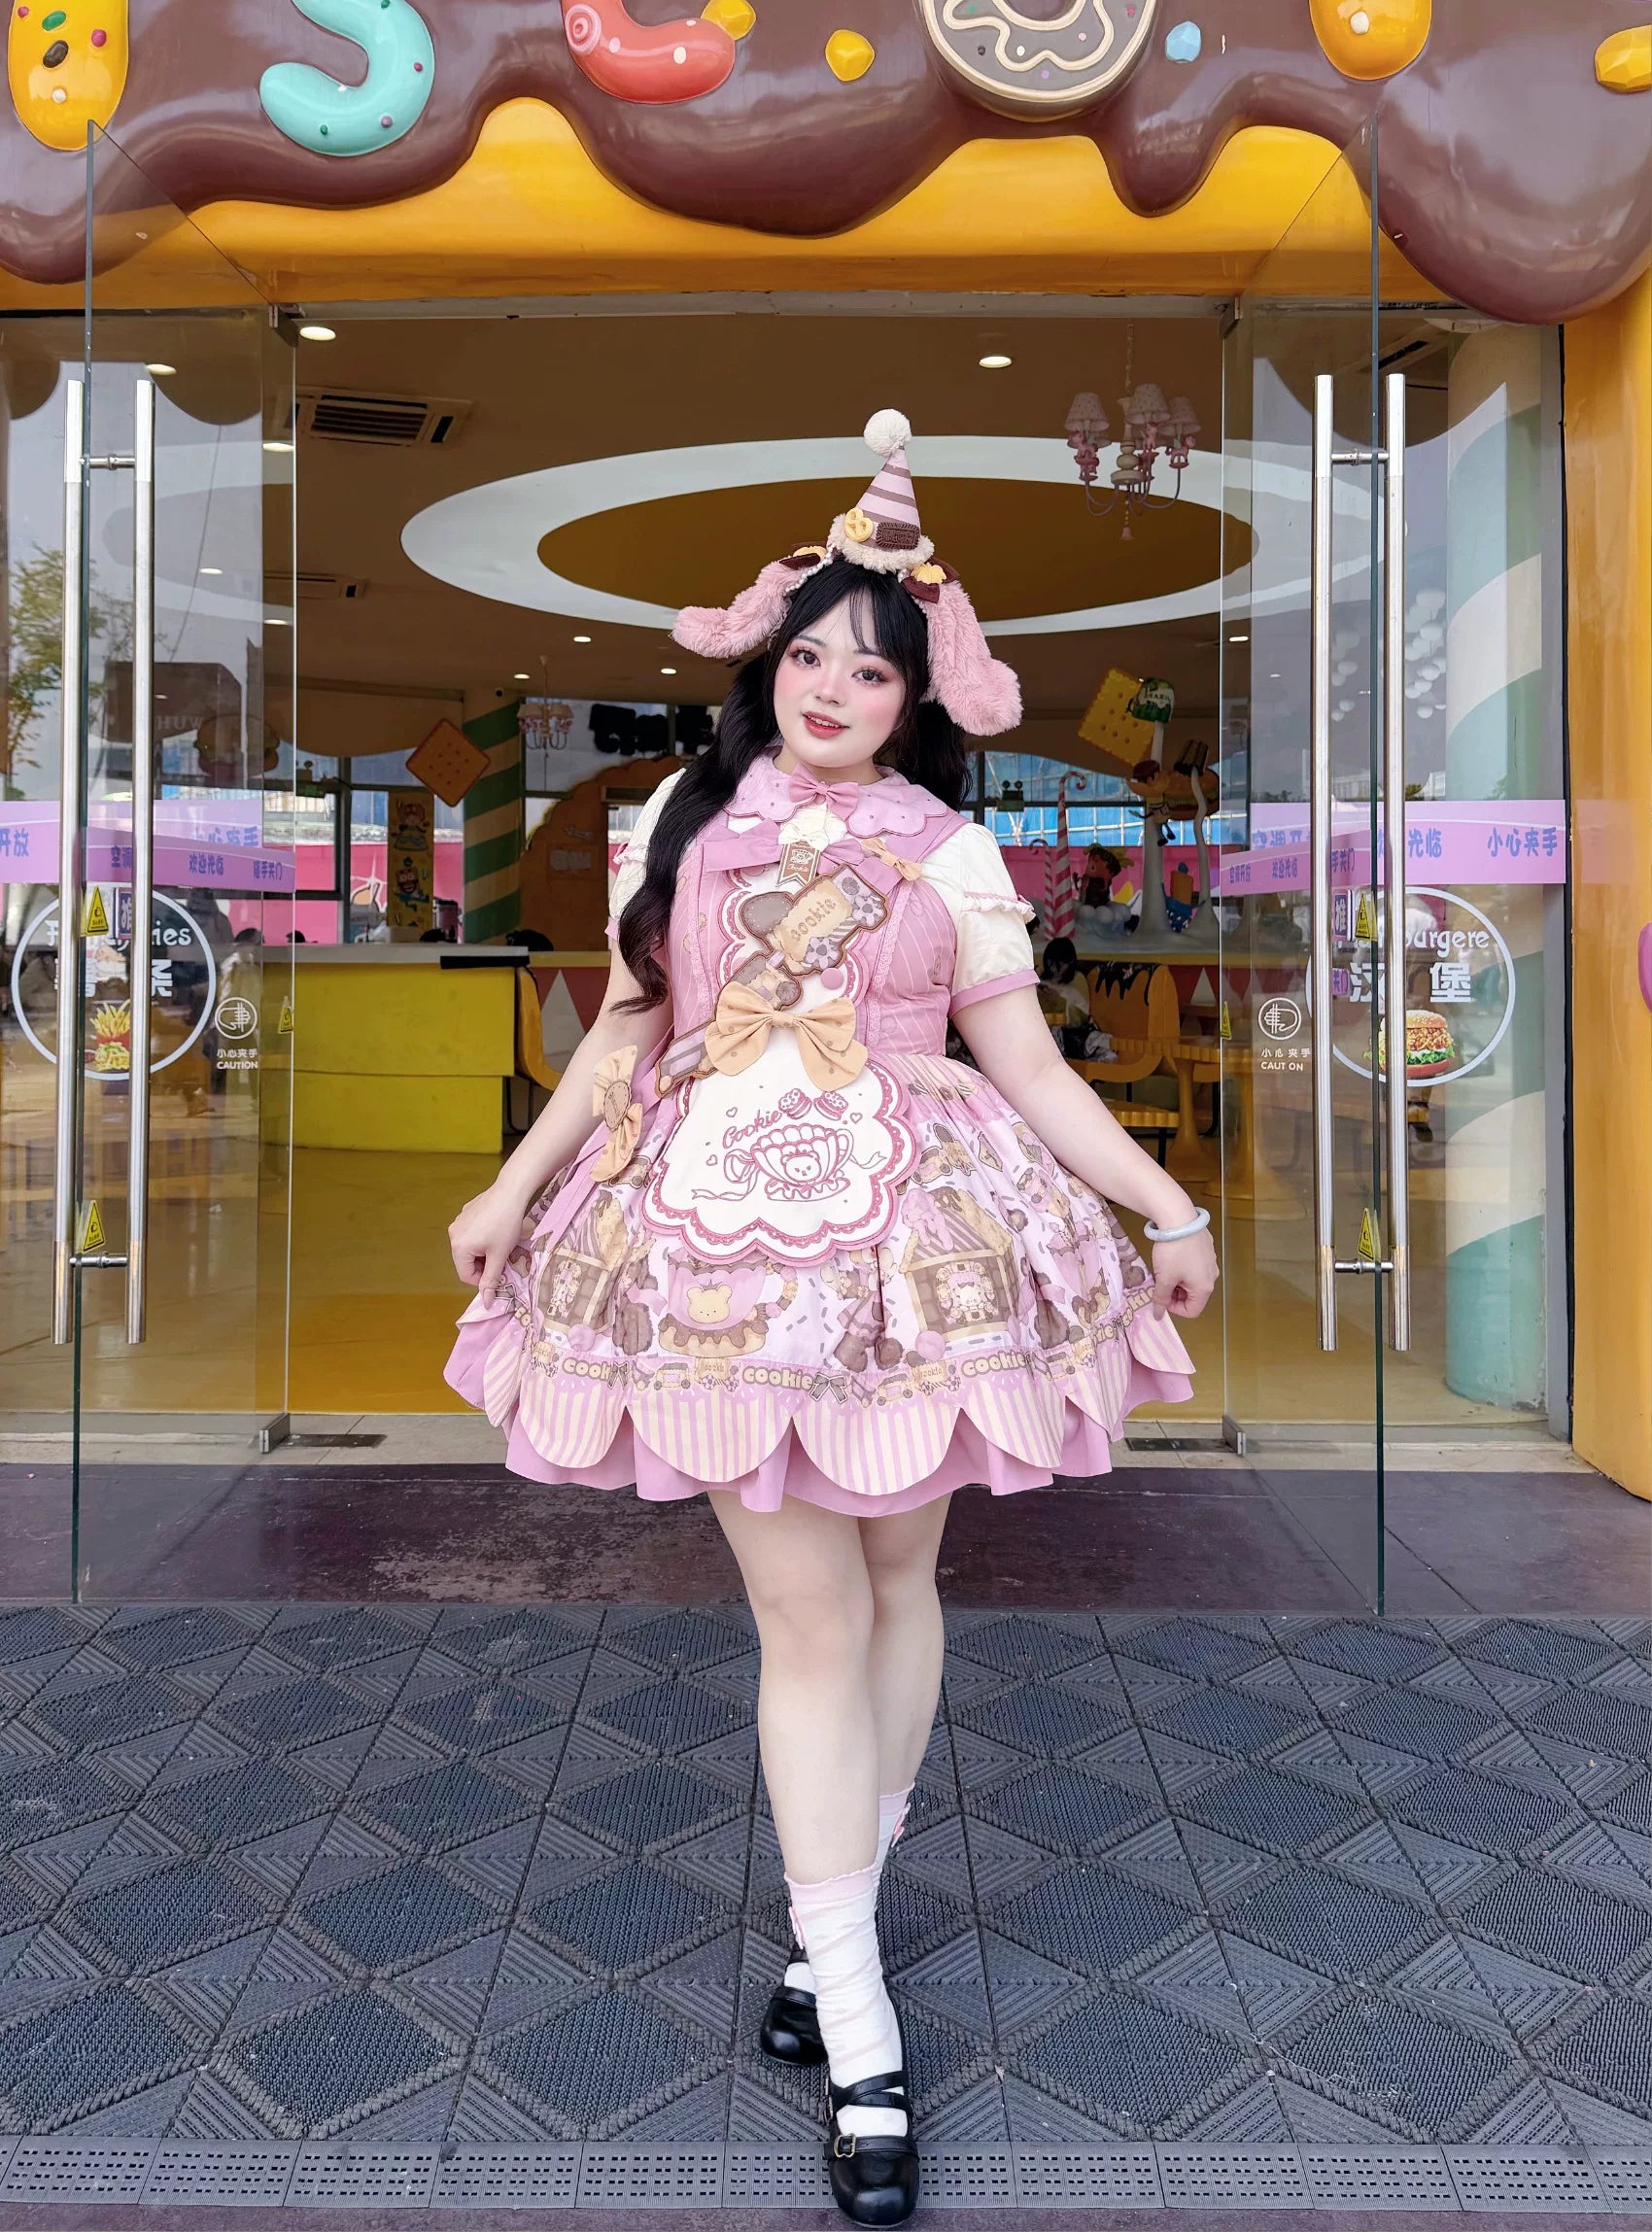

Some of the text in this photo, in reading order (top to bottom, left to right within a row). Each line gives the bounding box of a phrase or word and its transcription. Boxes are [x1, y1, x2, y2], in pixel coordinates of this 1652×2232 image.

[1487, 827, 1557, 857] 小心夹手
[1331, 847, 1356, 873] 手关门
[790, 898, 837, 942] cookie
[217, 1048, 258, 1058] 小心夹手
[217, 1061, 258, 1070] CAUTION
[1260, 1047, 1311, 1058] 小心夹手
[722, 1109, 782, 1150] Cookie
[742, 1365, 814, 1391] cookie
